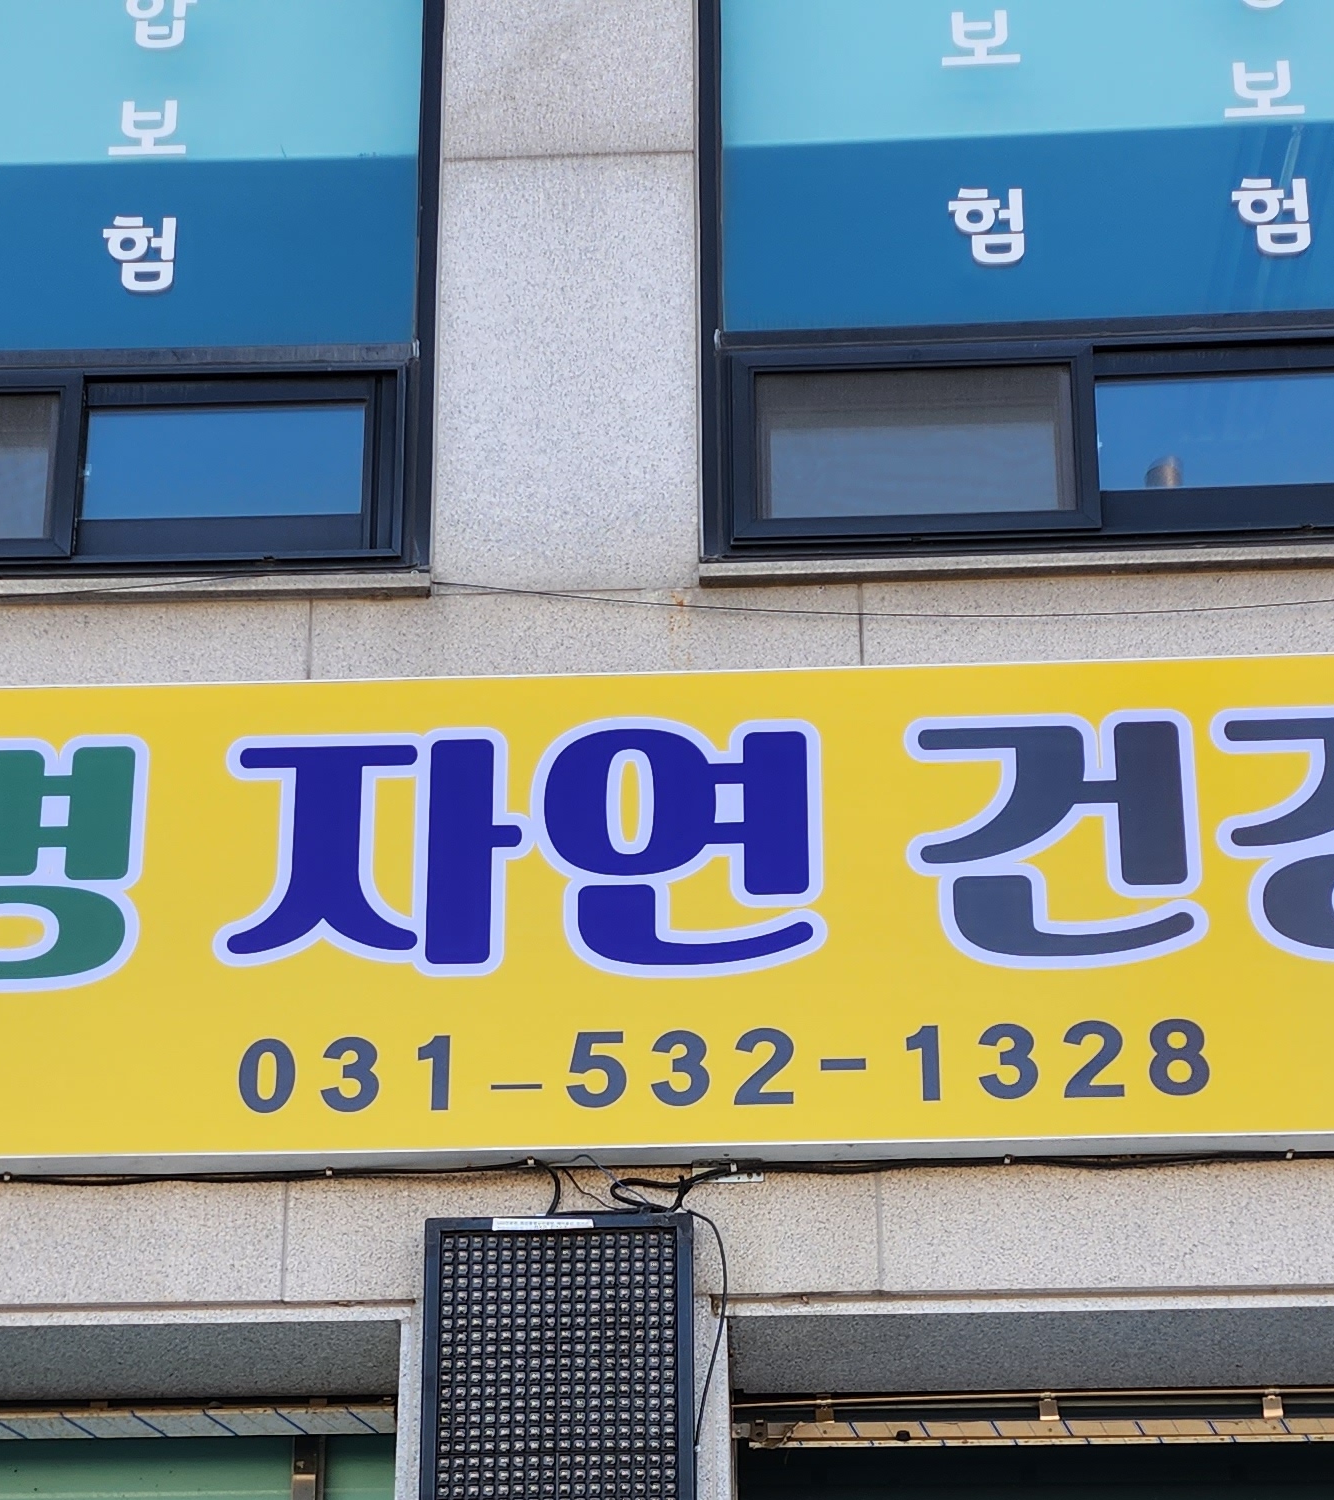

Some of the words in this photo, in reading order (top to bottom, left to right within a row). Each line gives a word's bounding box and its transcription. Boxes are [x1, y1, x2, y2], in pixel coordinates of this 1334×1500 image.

[1224, 0, 1312, 256] 보험
[212, 715, 828, 979] 자연
[236, 1018, 1212, 1113] 031-532-1328
